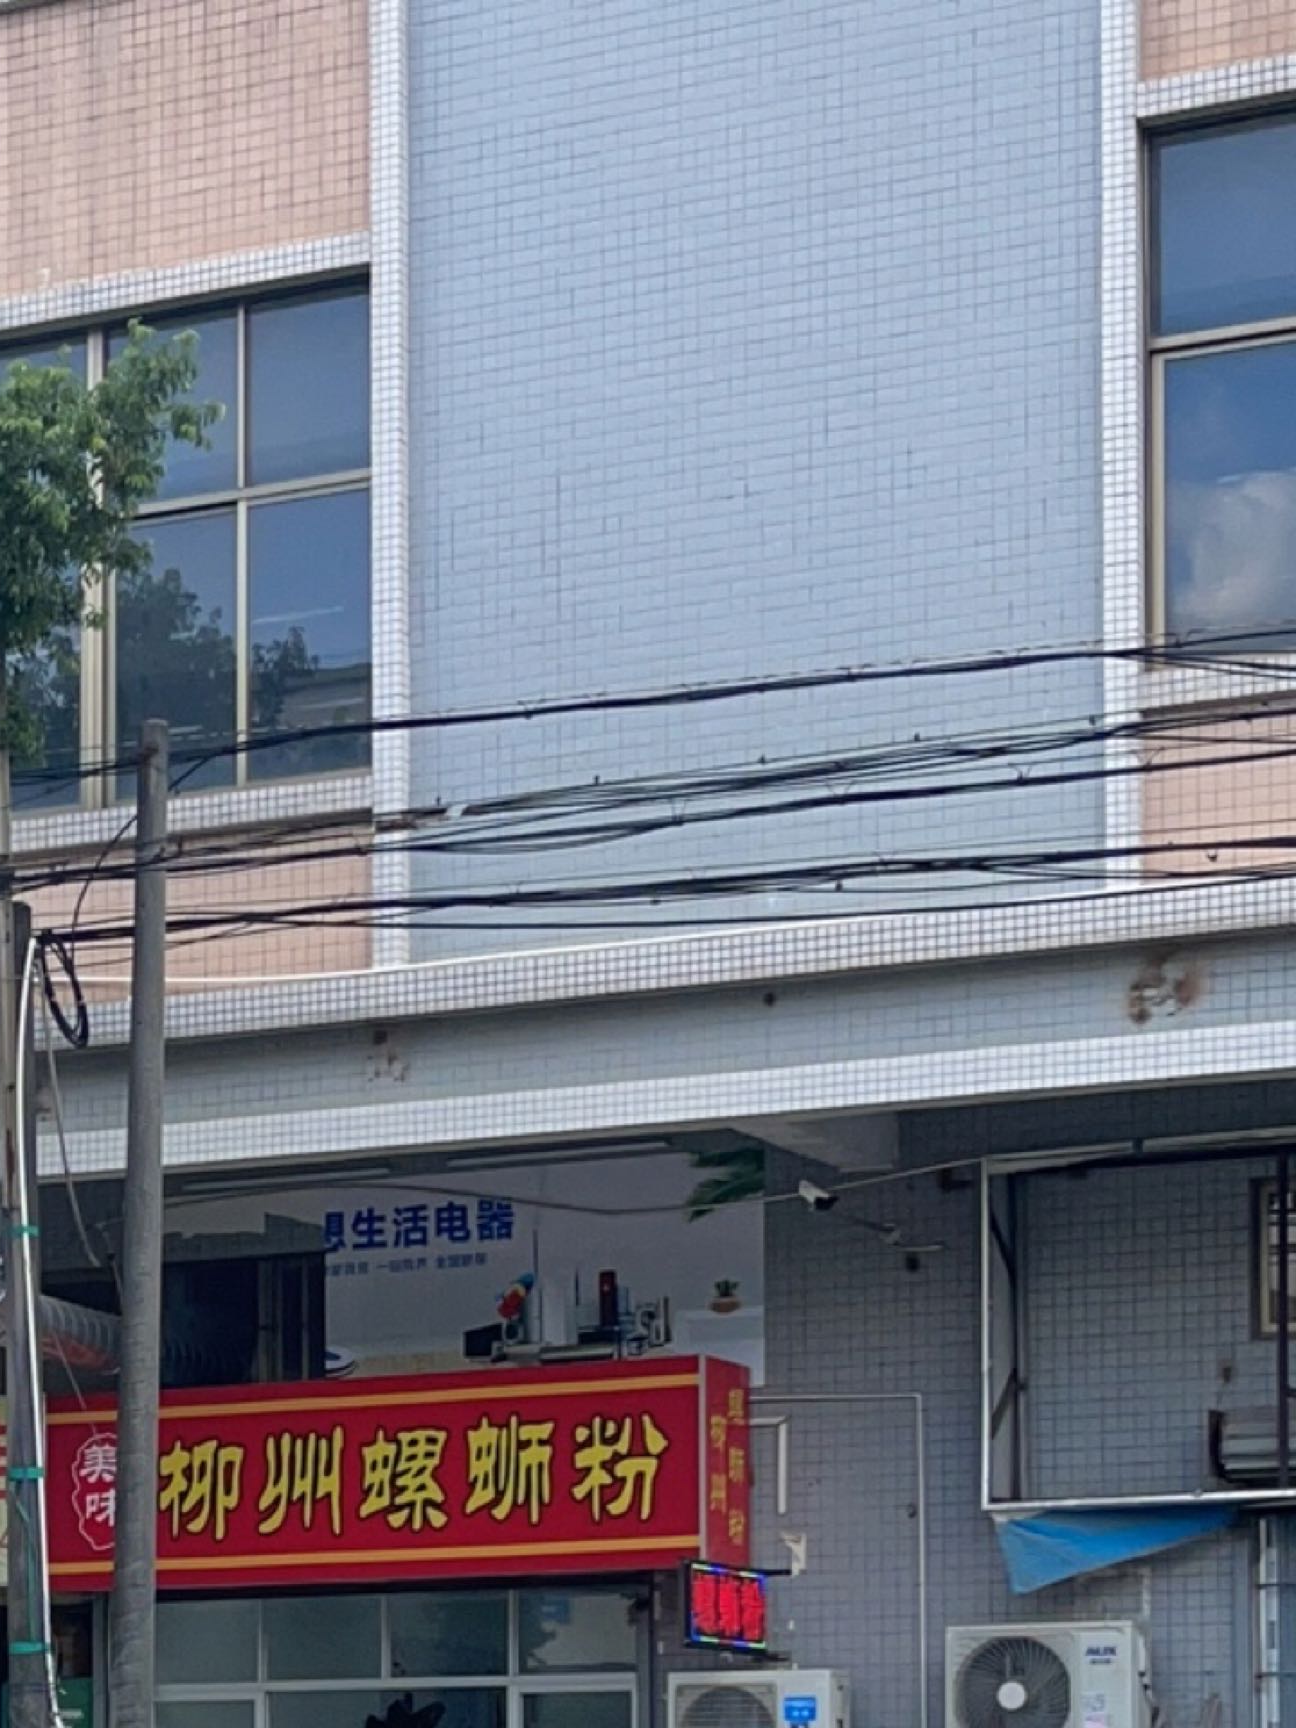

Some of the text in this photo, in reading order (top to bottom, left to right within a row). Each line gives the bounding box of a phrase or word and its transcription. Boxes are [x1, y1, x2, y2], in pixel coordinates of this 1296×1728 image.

[159, 1414, 667, 1540] 柳州螺蛳粉
